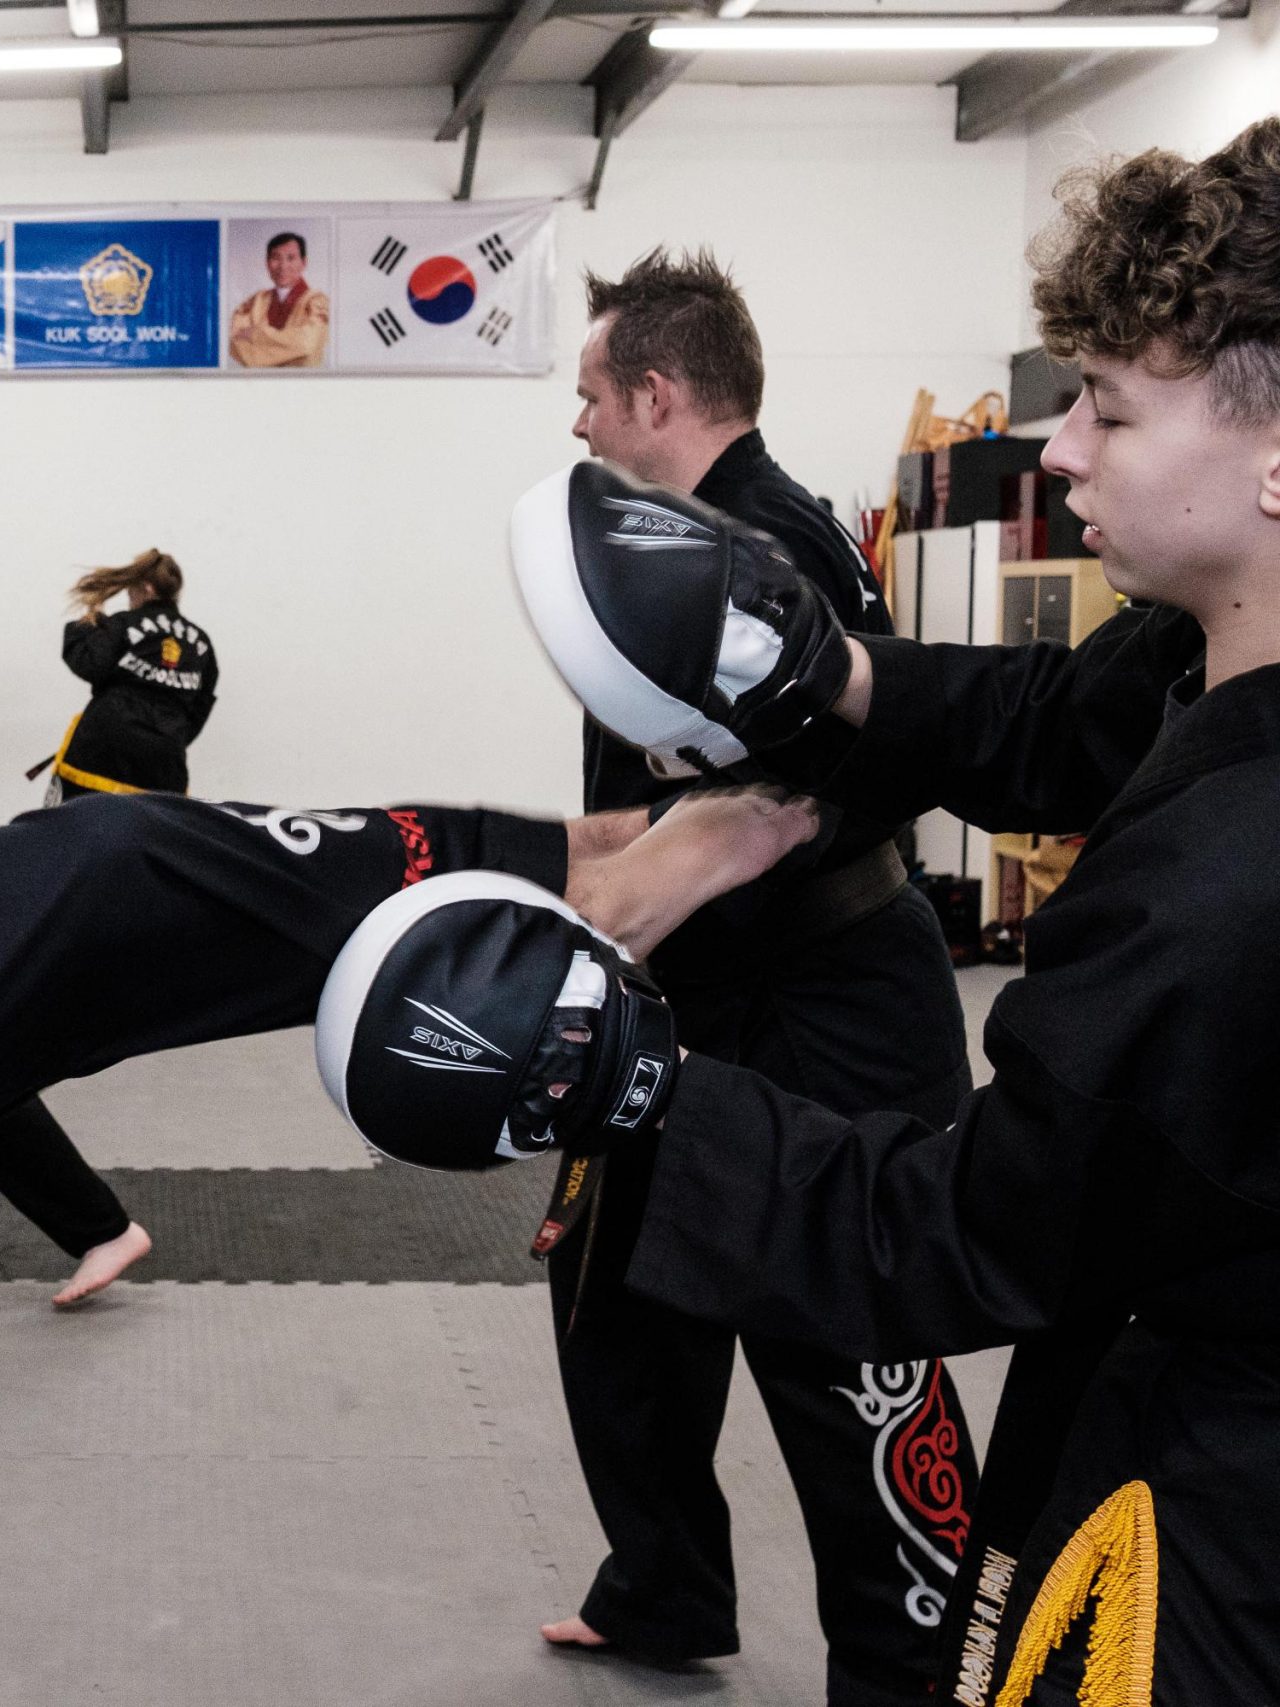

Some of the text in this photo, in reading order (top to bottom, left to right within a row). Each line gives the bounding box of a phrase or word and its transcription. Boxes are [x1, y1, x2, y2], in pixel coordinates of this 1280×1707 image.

[45, 326, 81, 343] KUK
[86, 326, 131, 343] SOOL
[619, 513, 691, 537] AXIS
[410, 1026, 482, 1060] AXIS
